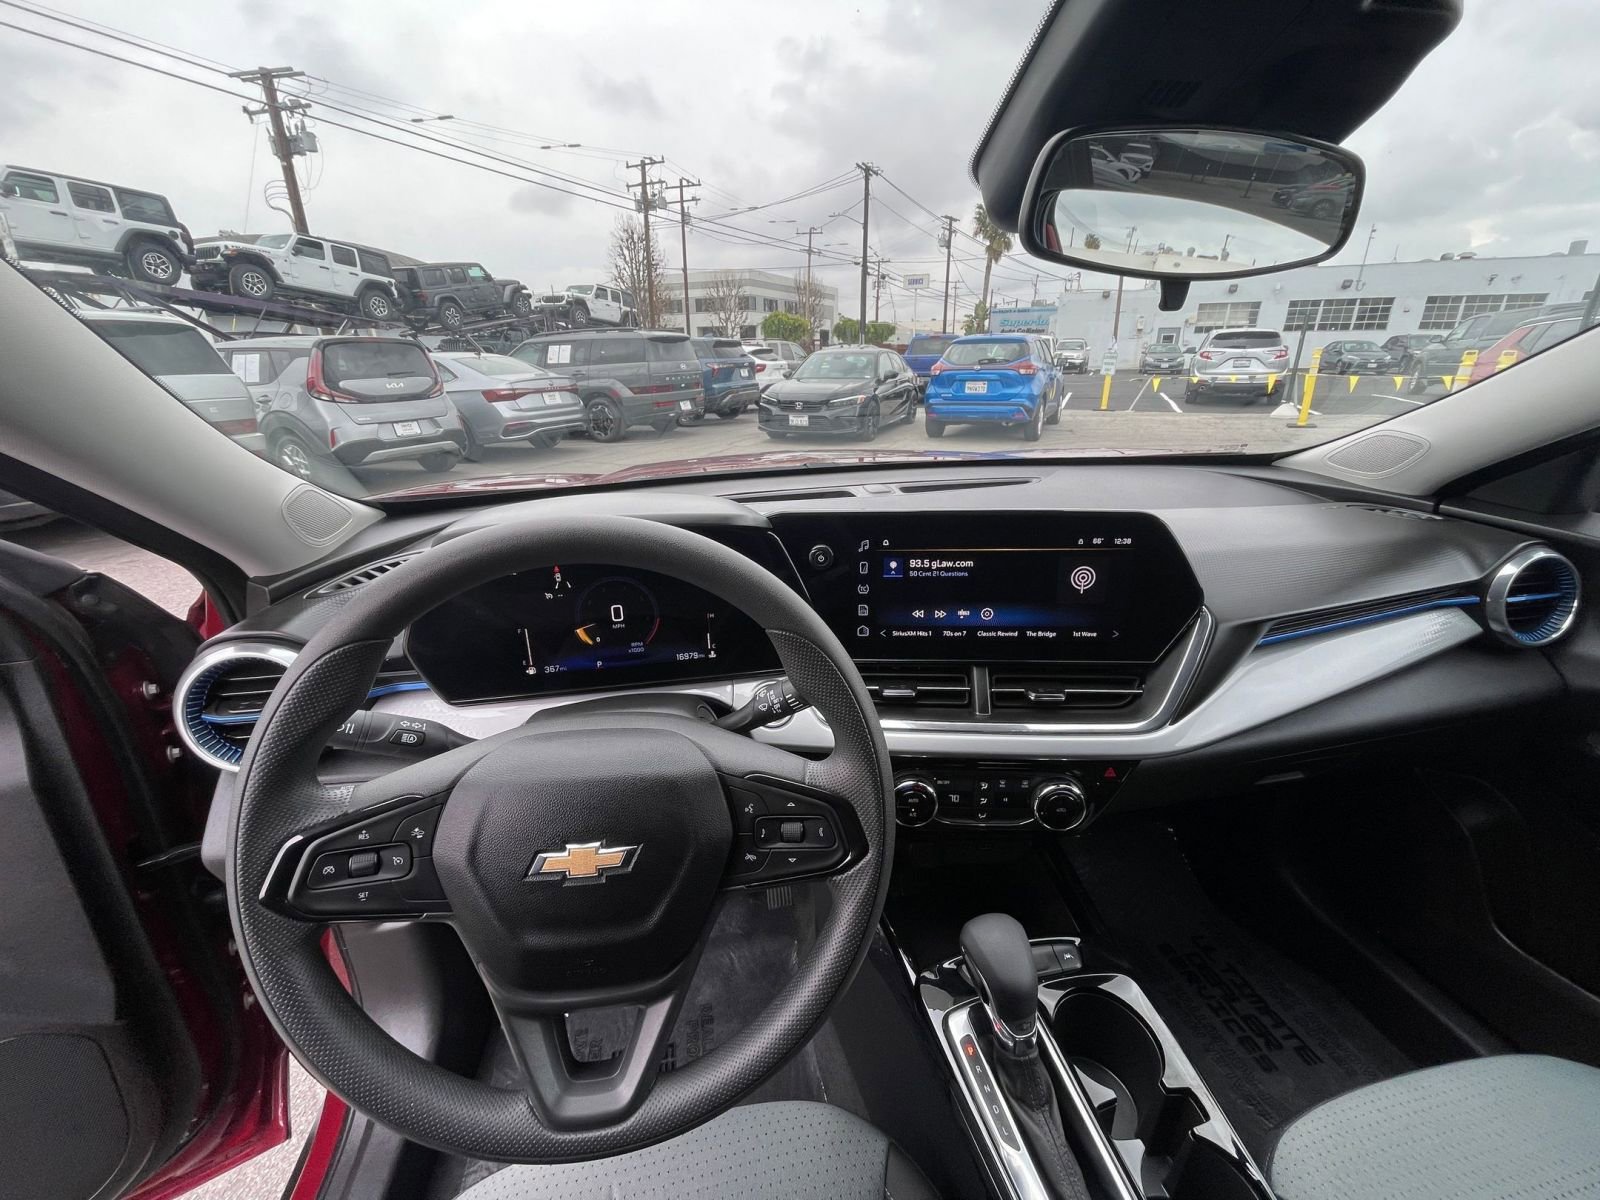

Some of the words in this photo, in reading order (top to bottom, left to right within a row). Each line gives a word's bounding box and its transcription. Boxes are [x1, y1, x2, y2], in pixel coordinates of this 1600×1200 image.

[909, 559, 930, 568] 93.5
[610, 604, 624, 622] 0
[1038, 630, 1057, 638] Bridge
[596, 660, 602, 668] P
[949, 794, 960, 803] 70
[967, 1046, 974, 1055] P
[975, 1065, 982, 1073] R
[984, 1084, 991, 1093] N
[993, 1105, 999, 1114] D
[1002, 1127, 1009, 1136] L
